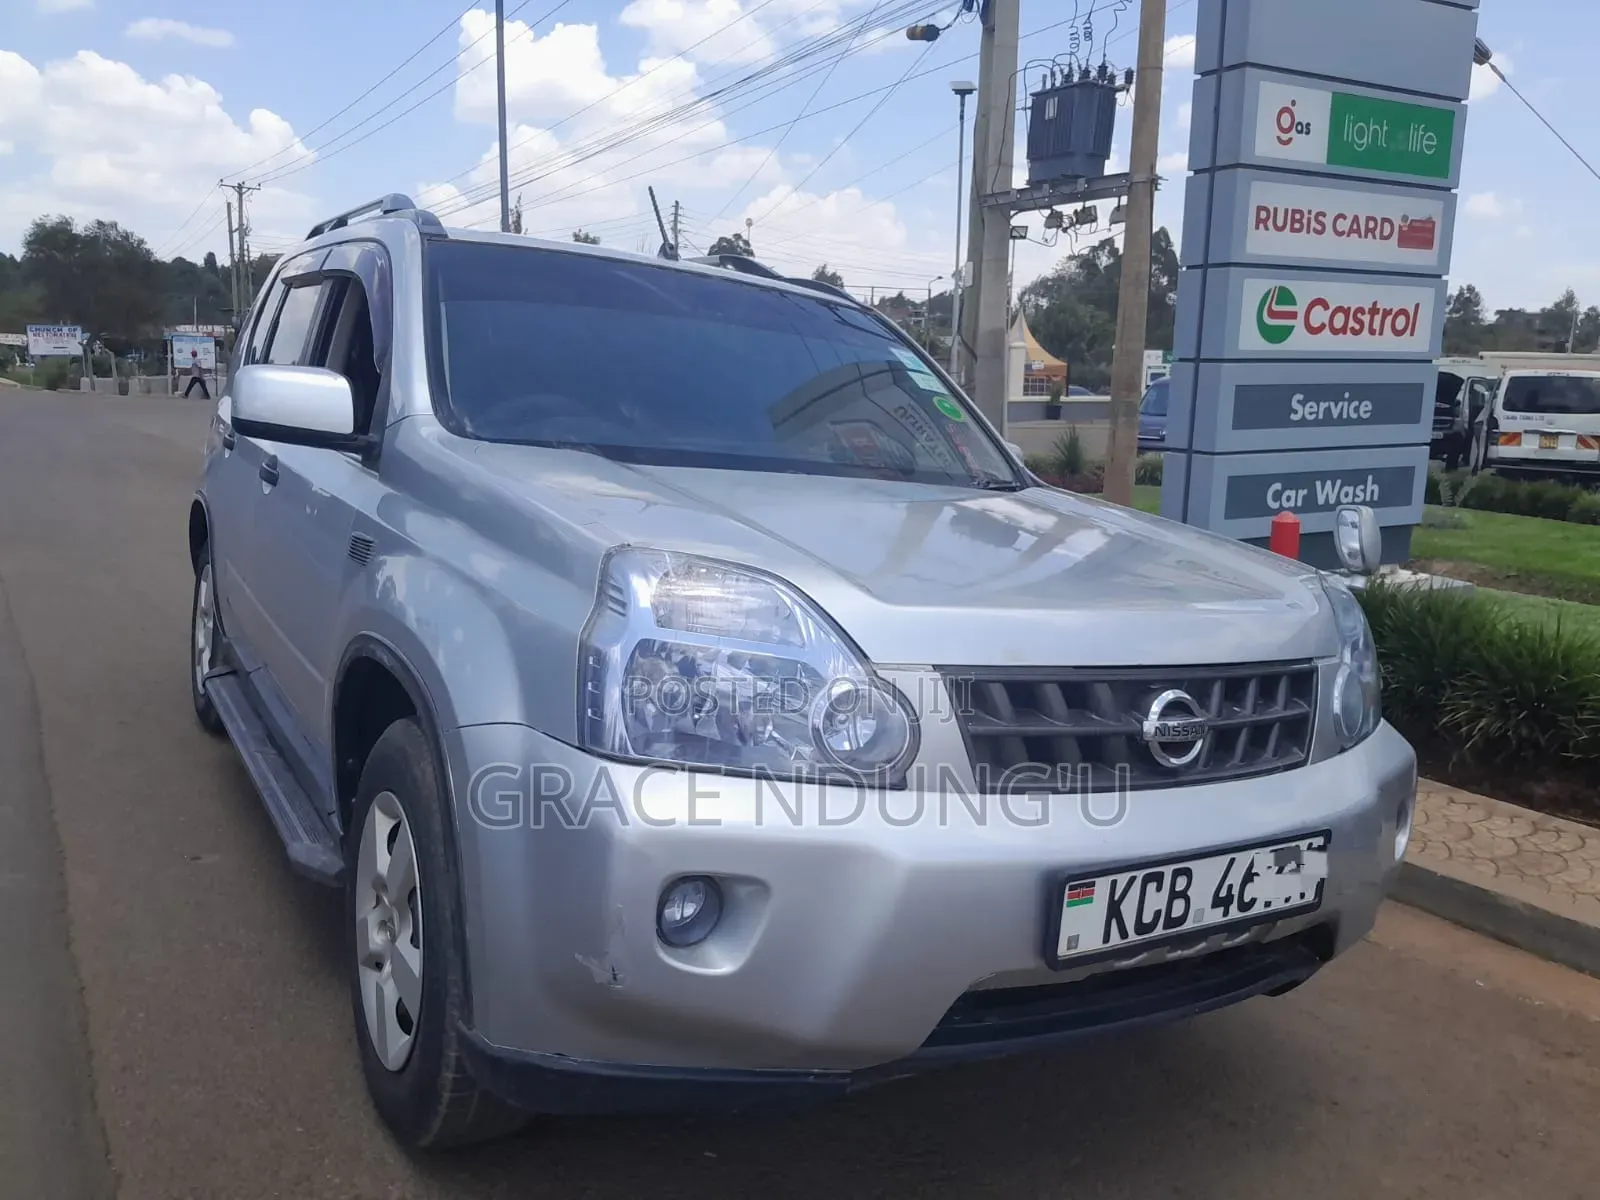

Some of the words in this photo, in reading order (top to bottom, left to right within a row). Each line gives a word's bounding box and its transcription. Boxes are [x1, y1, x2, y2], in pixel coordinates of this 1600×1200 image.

[1276, 99, 1311, 146] gas
[1343, 113, 1389, 151] light
[1408, 122, 1437, 155] life
[1332, 213, 1395, 241] CARD
[1304, 297, 1420, 337] Castrol
[1290, 392, 1373, 421] Service
[1266, 483, 1308, 509] Car
[1315, 475, 1380, 506] Wash
[1154, 723, 1205, 737] NISSAN
[1102, 866, 1193, 944] KCB
